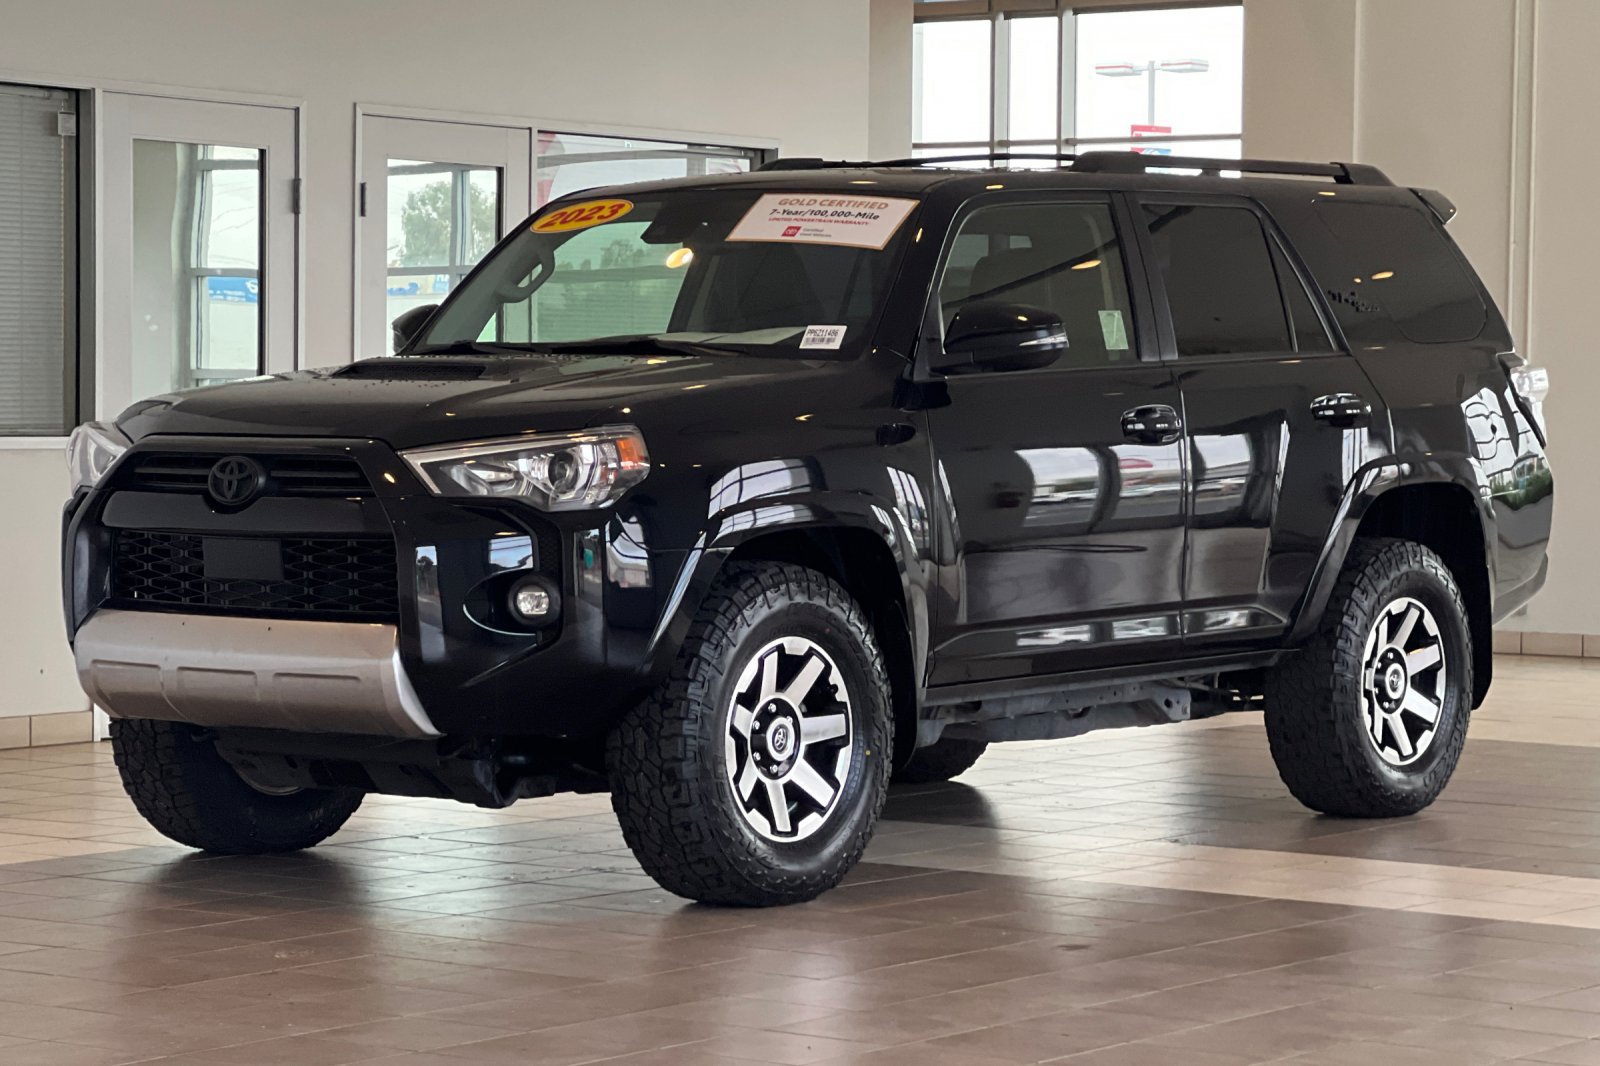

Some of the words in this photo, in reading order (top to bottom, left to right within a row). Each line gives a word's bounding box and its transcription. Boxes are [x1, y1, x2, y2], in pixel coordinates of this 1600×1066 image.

[778, 198, 818, 206] GOLD
[819, 199, 889, 210] CERTIFIED
[538, 203, 626, 229] 2023
[769, 208, 880, 220] 7-Year/100,000-Mile
